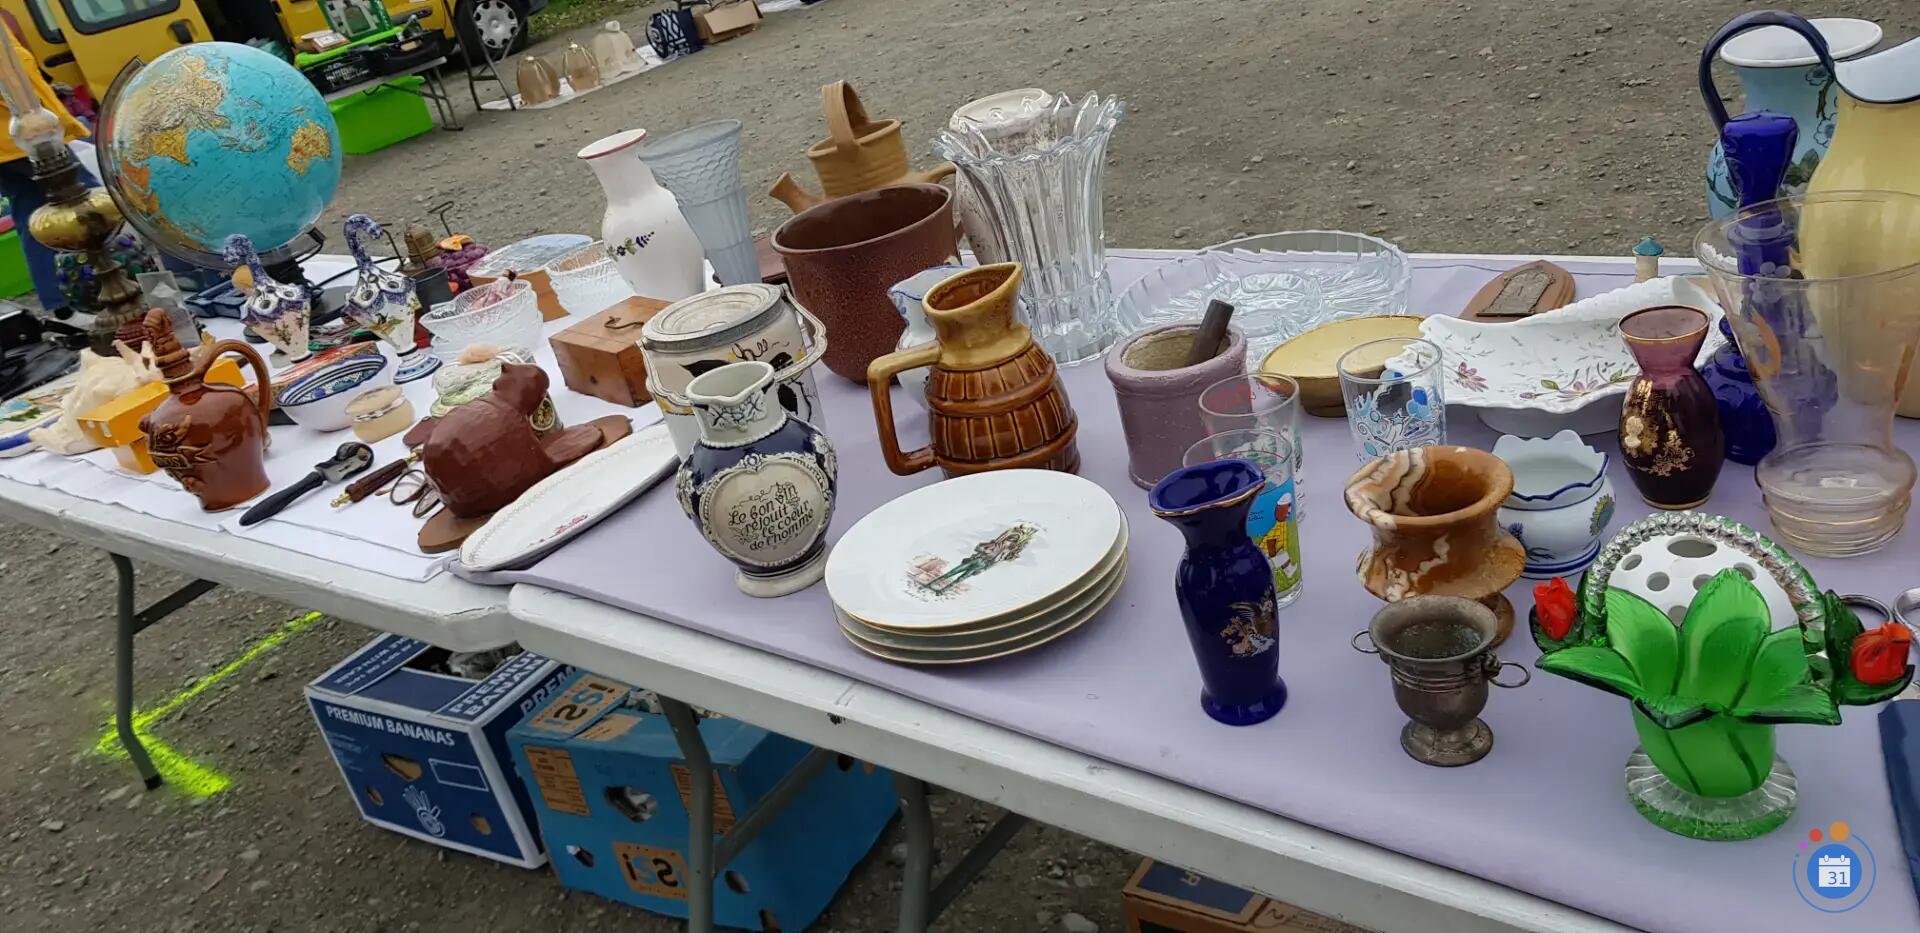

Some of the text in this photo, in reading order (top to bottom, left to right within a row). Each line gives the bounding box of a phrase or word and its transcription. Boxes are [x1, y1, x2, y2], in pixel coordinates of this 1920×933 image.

[728, 484, 798, 526] Le bon vin
[762, 500, 809, 538] le coeur
[749, 538, 765, 551] de
[326, 704, 456, 747] PREMIUM BANANAS
